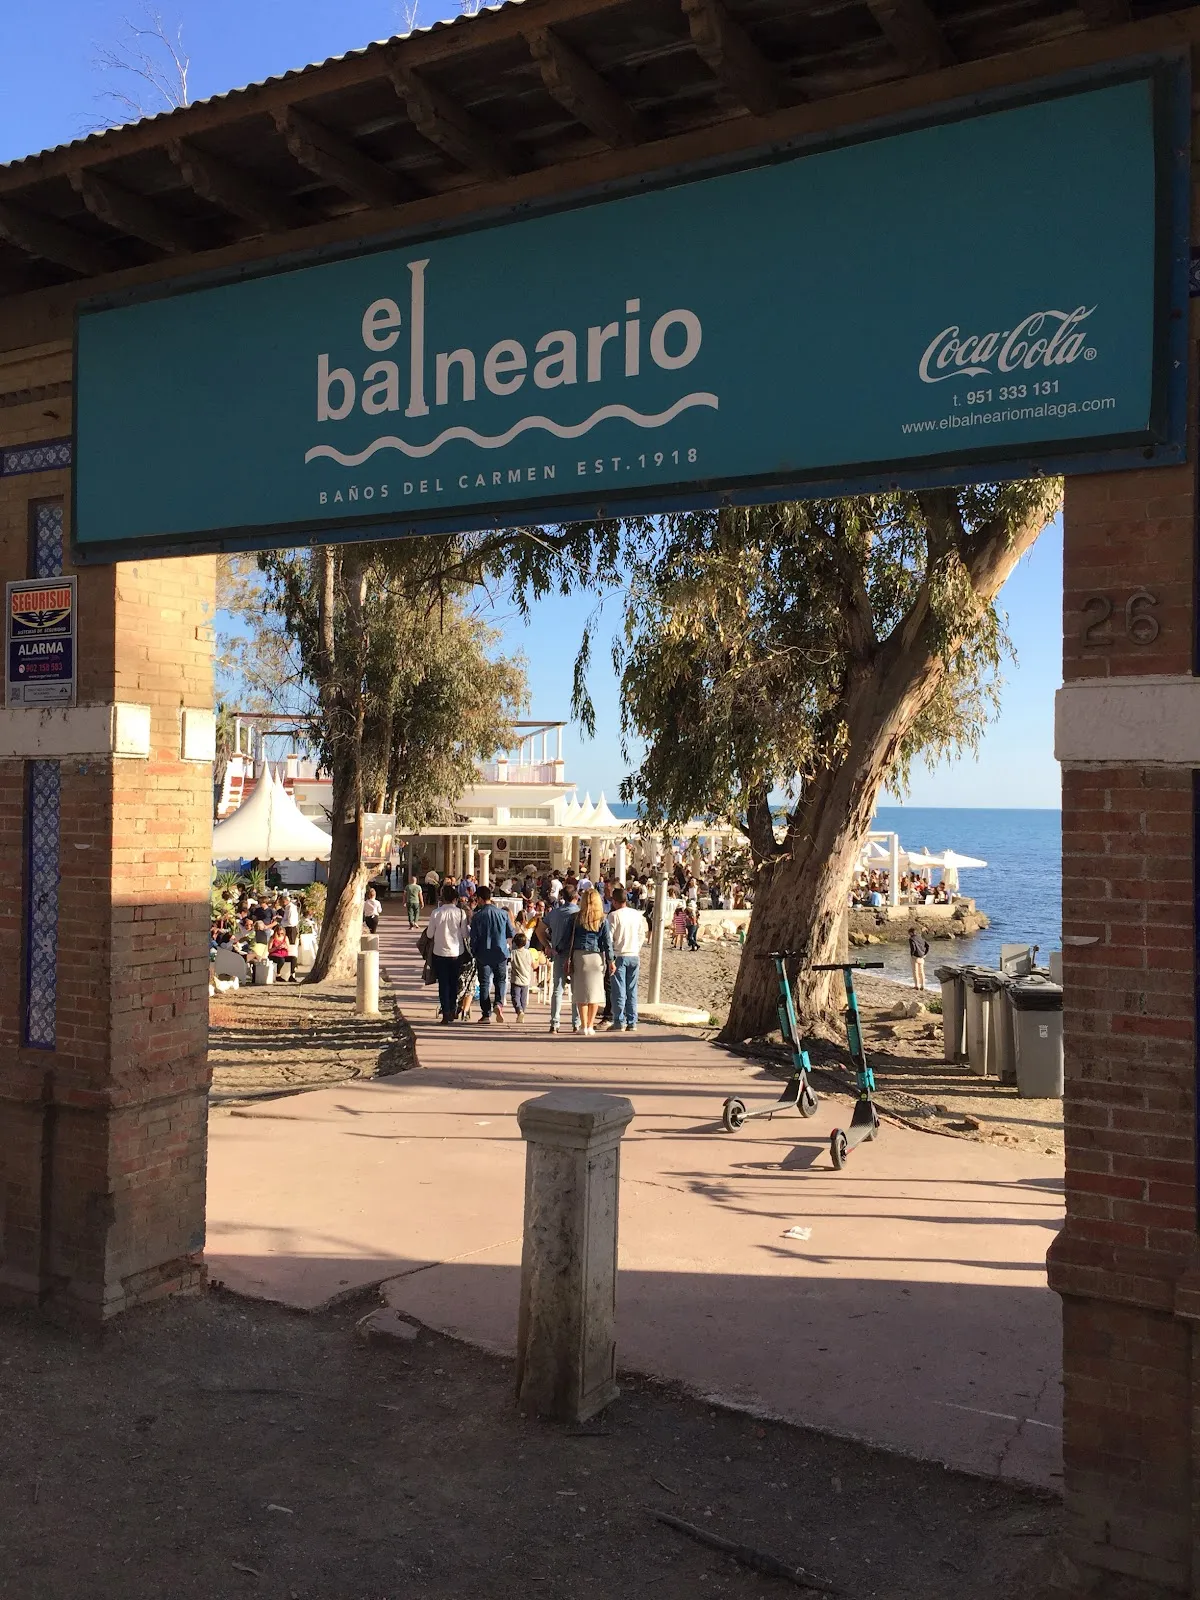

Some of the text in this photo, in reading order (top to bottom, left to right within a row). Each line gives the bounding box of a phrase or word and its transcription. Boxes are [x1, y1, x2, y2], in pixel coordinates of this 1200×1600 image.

[317, 297, 703, 422] balneario
[952, 379, 1060, 407] t. 951 333 131
[901, 397, 1116, 434] www.elbalneariomalaga.com
[319, 483, 389, 505] BAÑOS
[403, 478, 444, 495] DEL
[458, 464, 556, 489] CARMEN
[12, 589, 71, 613] SEGURISUR
[1081, 592, 1160, 648] 26
[18, 641, 64, 656] ALARMA
